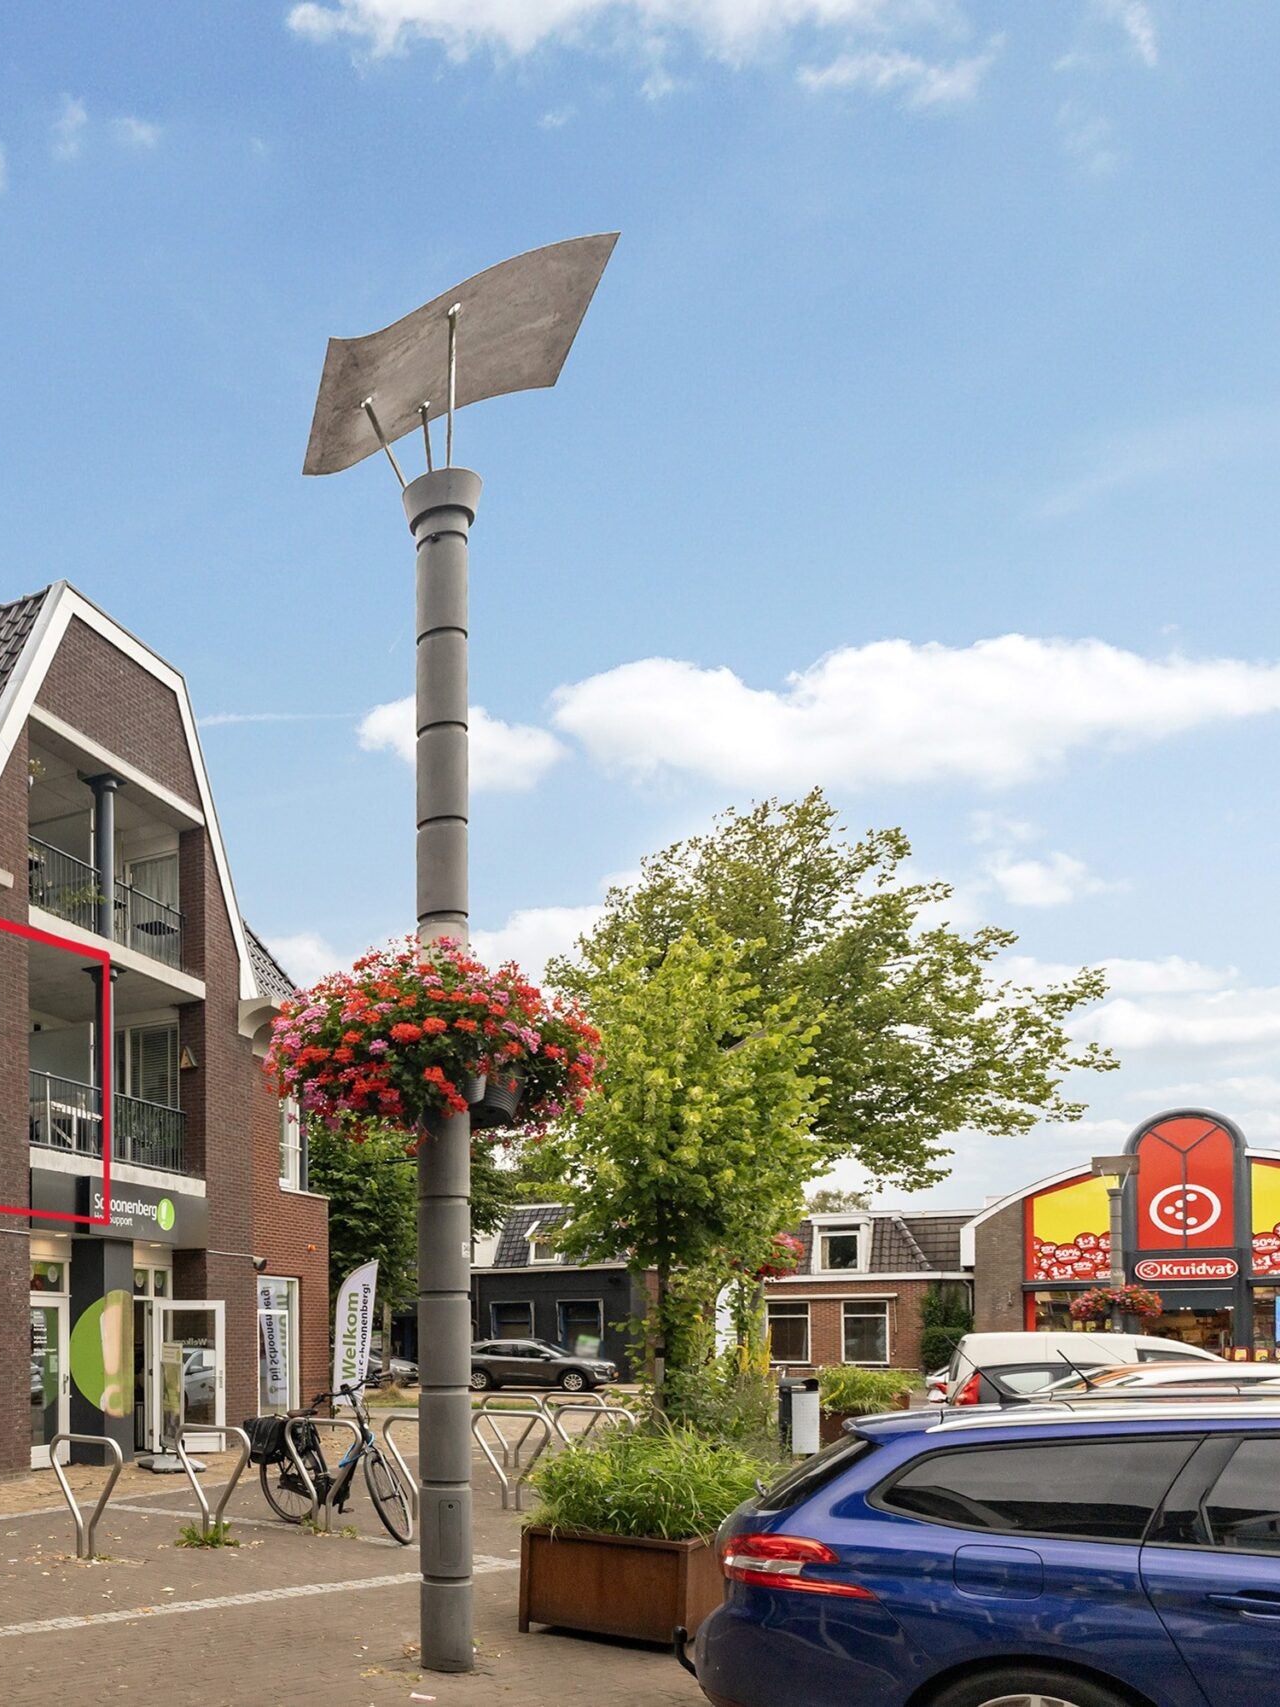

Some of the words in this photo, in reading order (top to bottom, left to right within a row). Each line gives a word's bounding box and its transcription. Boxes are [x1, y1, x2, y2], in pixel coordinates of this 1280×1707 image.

[94, 1193, 158, 1221] Scoonenberg
[1055, 1248, 1081, 1257] 50%
[1161, 1263, 1234, 1276] Kruidvat
[341, 1291, 360, 1381] Welkom
